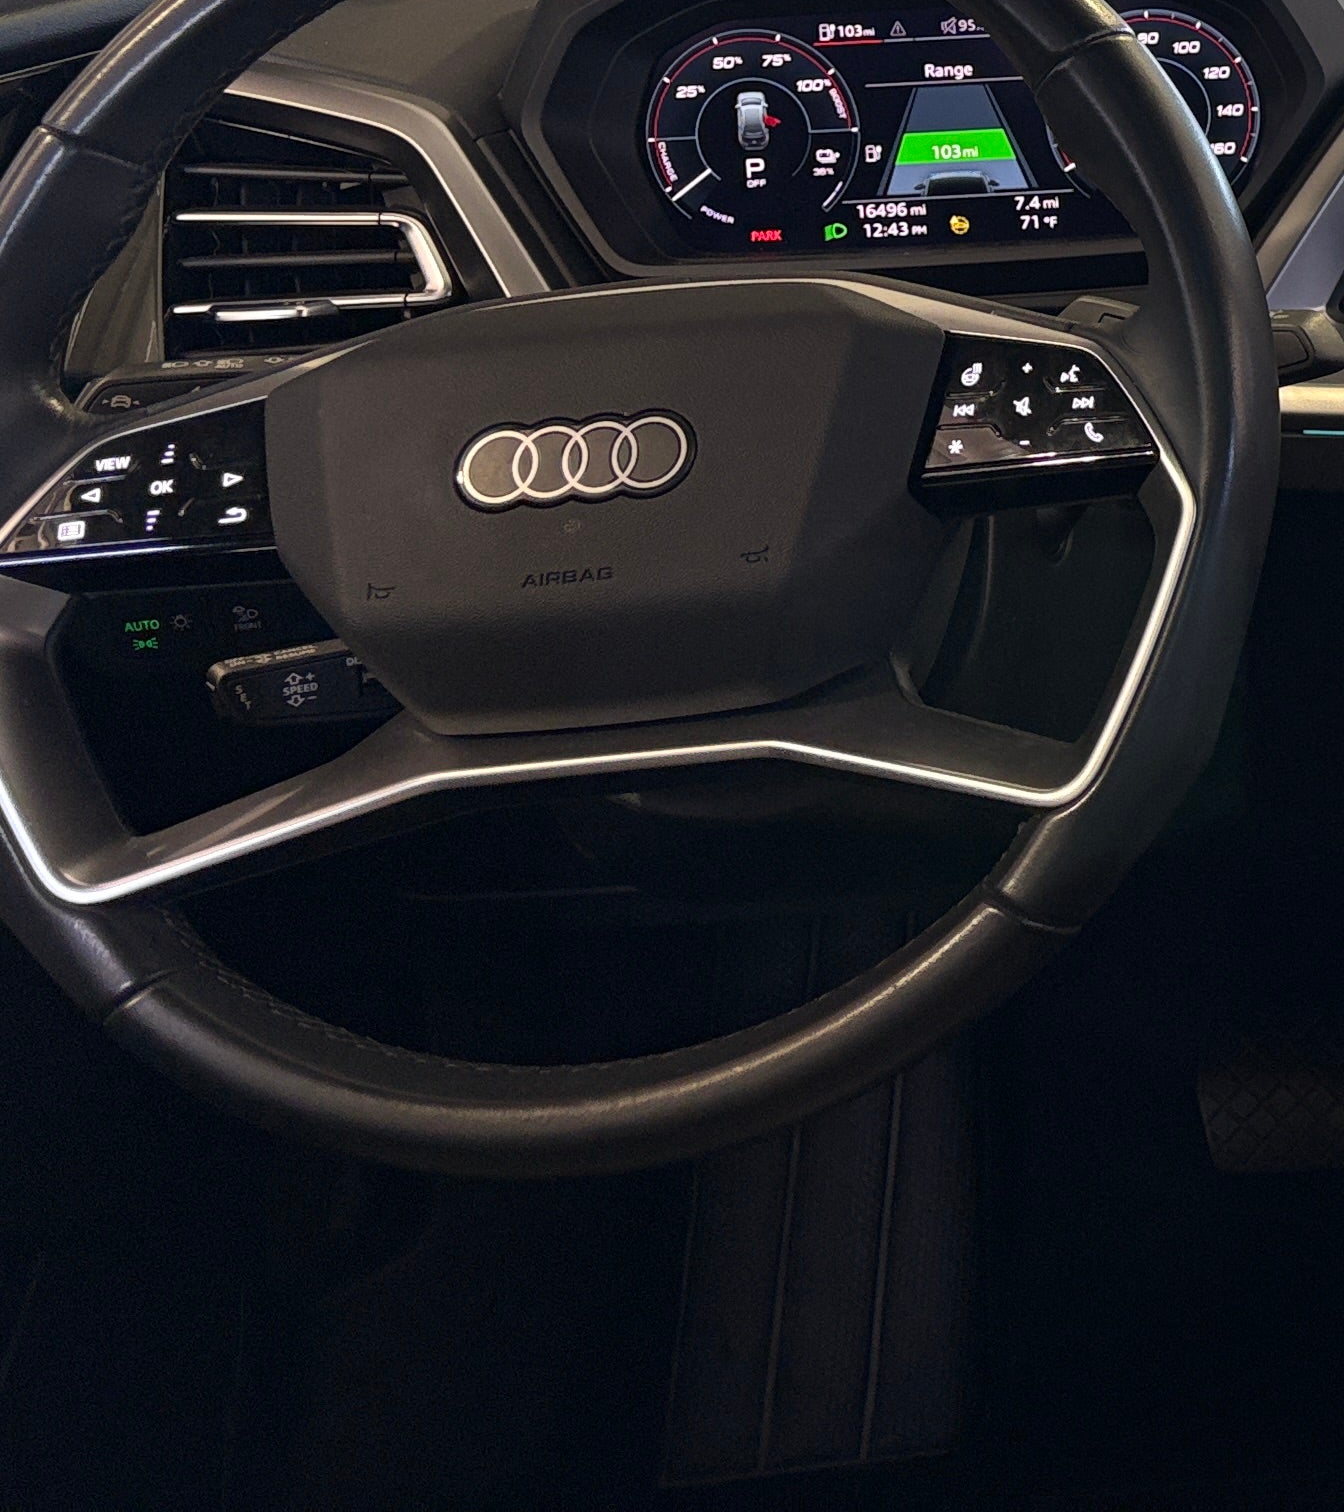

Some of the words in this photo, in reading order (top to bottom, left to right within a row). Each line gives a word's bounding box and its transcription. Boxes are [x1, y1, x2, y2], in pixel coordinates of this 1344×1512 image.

[1172, 40, 1200, 55] 100
[711, 56, 744, 70] 50%
[761, 53, 792, 68] 75%
[924, 63, 975, 80] Range
[1202, 66, 1231, 80] 120
[675, 84, 706, 99] 25%
[796, 78, 833, 93] 100%
[1216, 103, 1245, 117] 140
[657, 141, 680, 183] CHARGE
[744, 158, 766, 179] P
[746, 178, 767, 189] OFF
[856, 203, 908, 219] 16496
[909, 204, 928, 217] mi
[1014, 196, 1041, 211] 7.4
[1043, 196, 1060, 209] mi
[699, 204, 736, 224] POWER
[863, 222, 909, 238] 12:43
[911, 224, 928, 236] PM
[1020, 215, 1039, 230] 71
[750, 230, 783, 242] PARK
[95, 456, 131, 473] VIEW
[149, 478, 174, 496] OK
[521, 566, 613, 588] AIRBAG
[124, 619, 160, 633] AUTO
[282, 682, 320, 697] SPEED
[234, 684, 252, 711] SET
